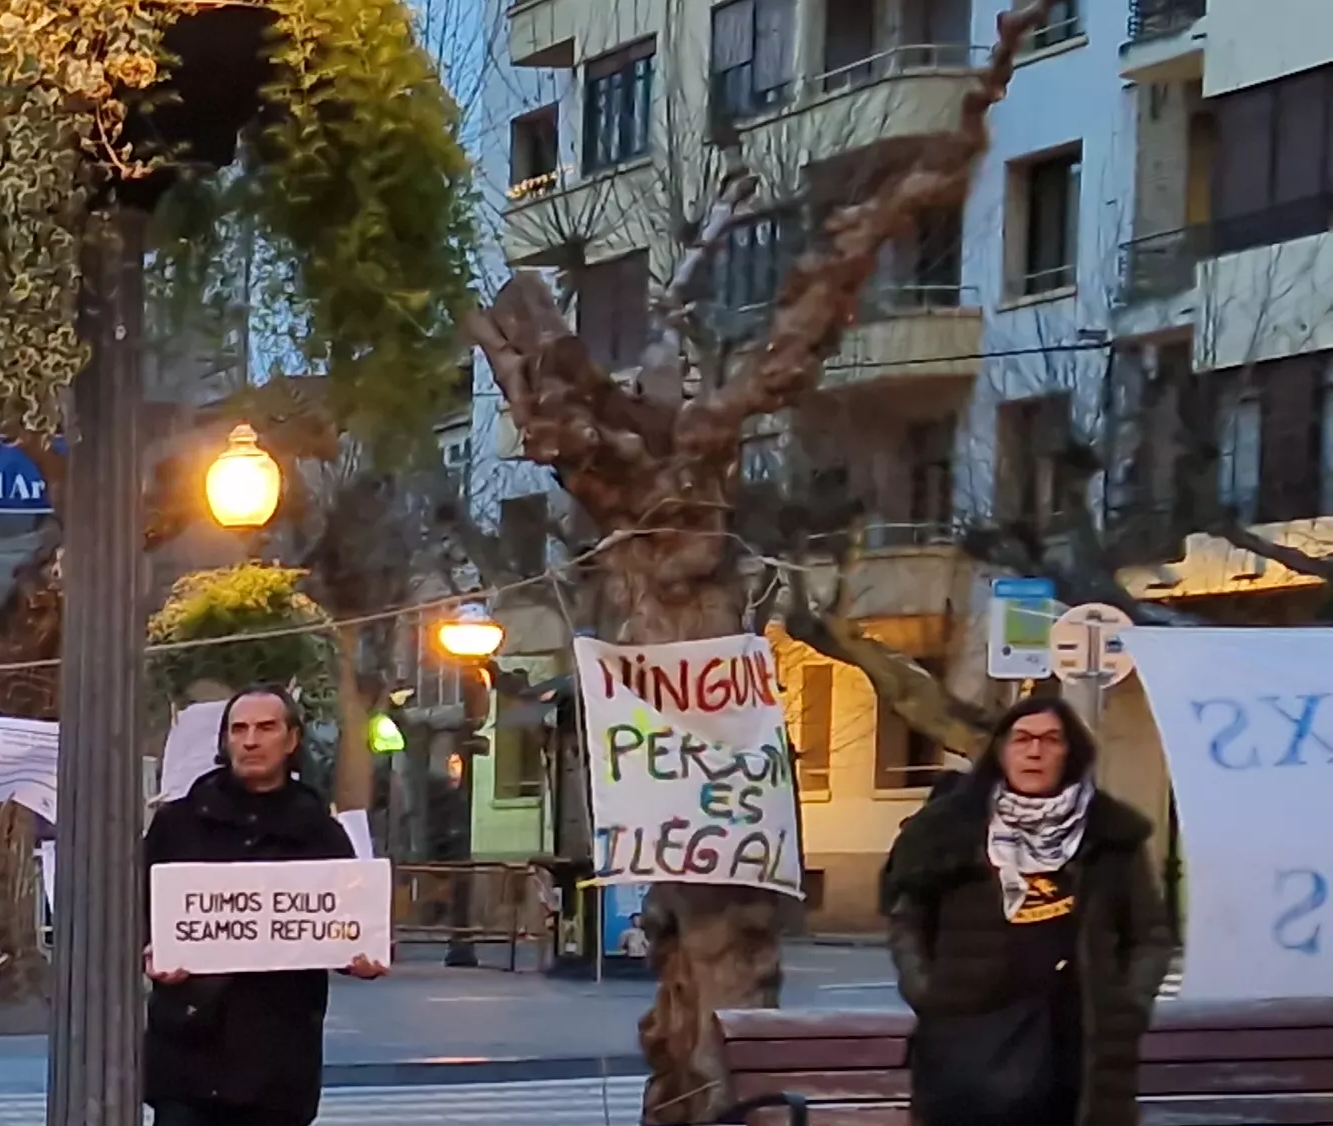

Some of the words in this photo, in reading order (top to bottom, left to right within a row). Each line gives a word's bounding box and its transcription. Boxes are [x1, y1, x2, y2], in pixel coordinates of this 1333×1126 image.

[700, 782, 764, 824] ES
[594, 817, 801, 889] ILEGAL
[185, 892, 262, 914] FUIMOS
[273, 891, 336, 914] EXILIO
[175, 920, 257, 942] SEAMOS
[270, 921, 361, 941] REFUGIO
